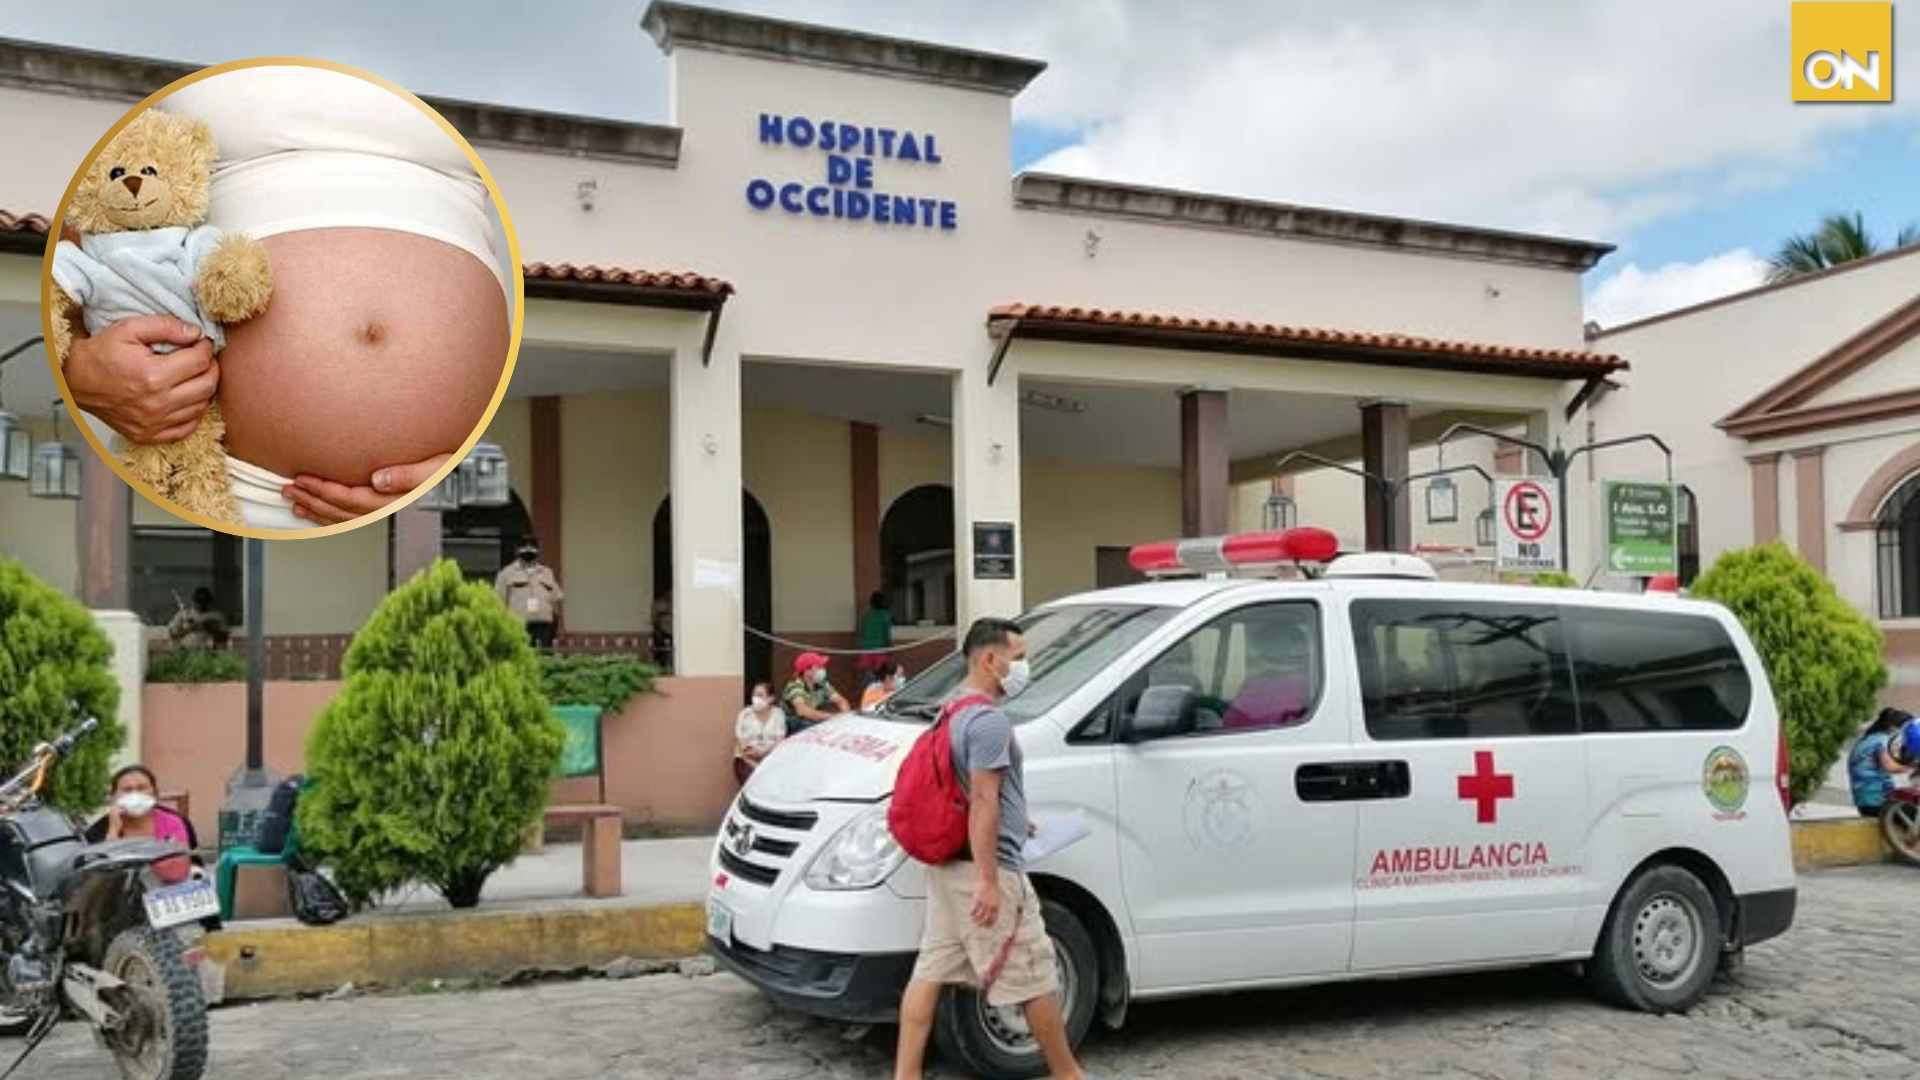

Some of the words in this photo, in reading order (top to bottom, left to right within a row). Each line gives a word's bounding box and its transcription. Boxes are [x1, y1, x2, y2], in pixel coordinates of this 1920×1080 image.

[759, 113, 942, 164] HOSPITAL
[827, 154, 874, 189] DE
[746, 178, 958, 231] OCCIDENTE
[1518, 543, 1541, 558] NO
[1370, 841, 1549, 874] AMBULANCIA
